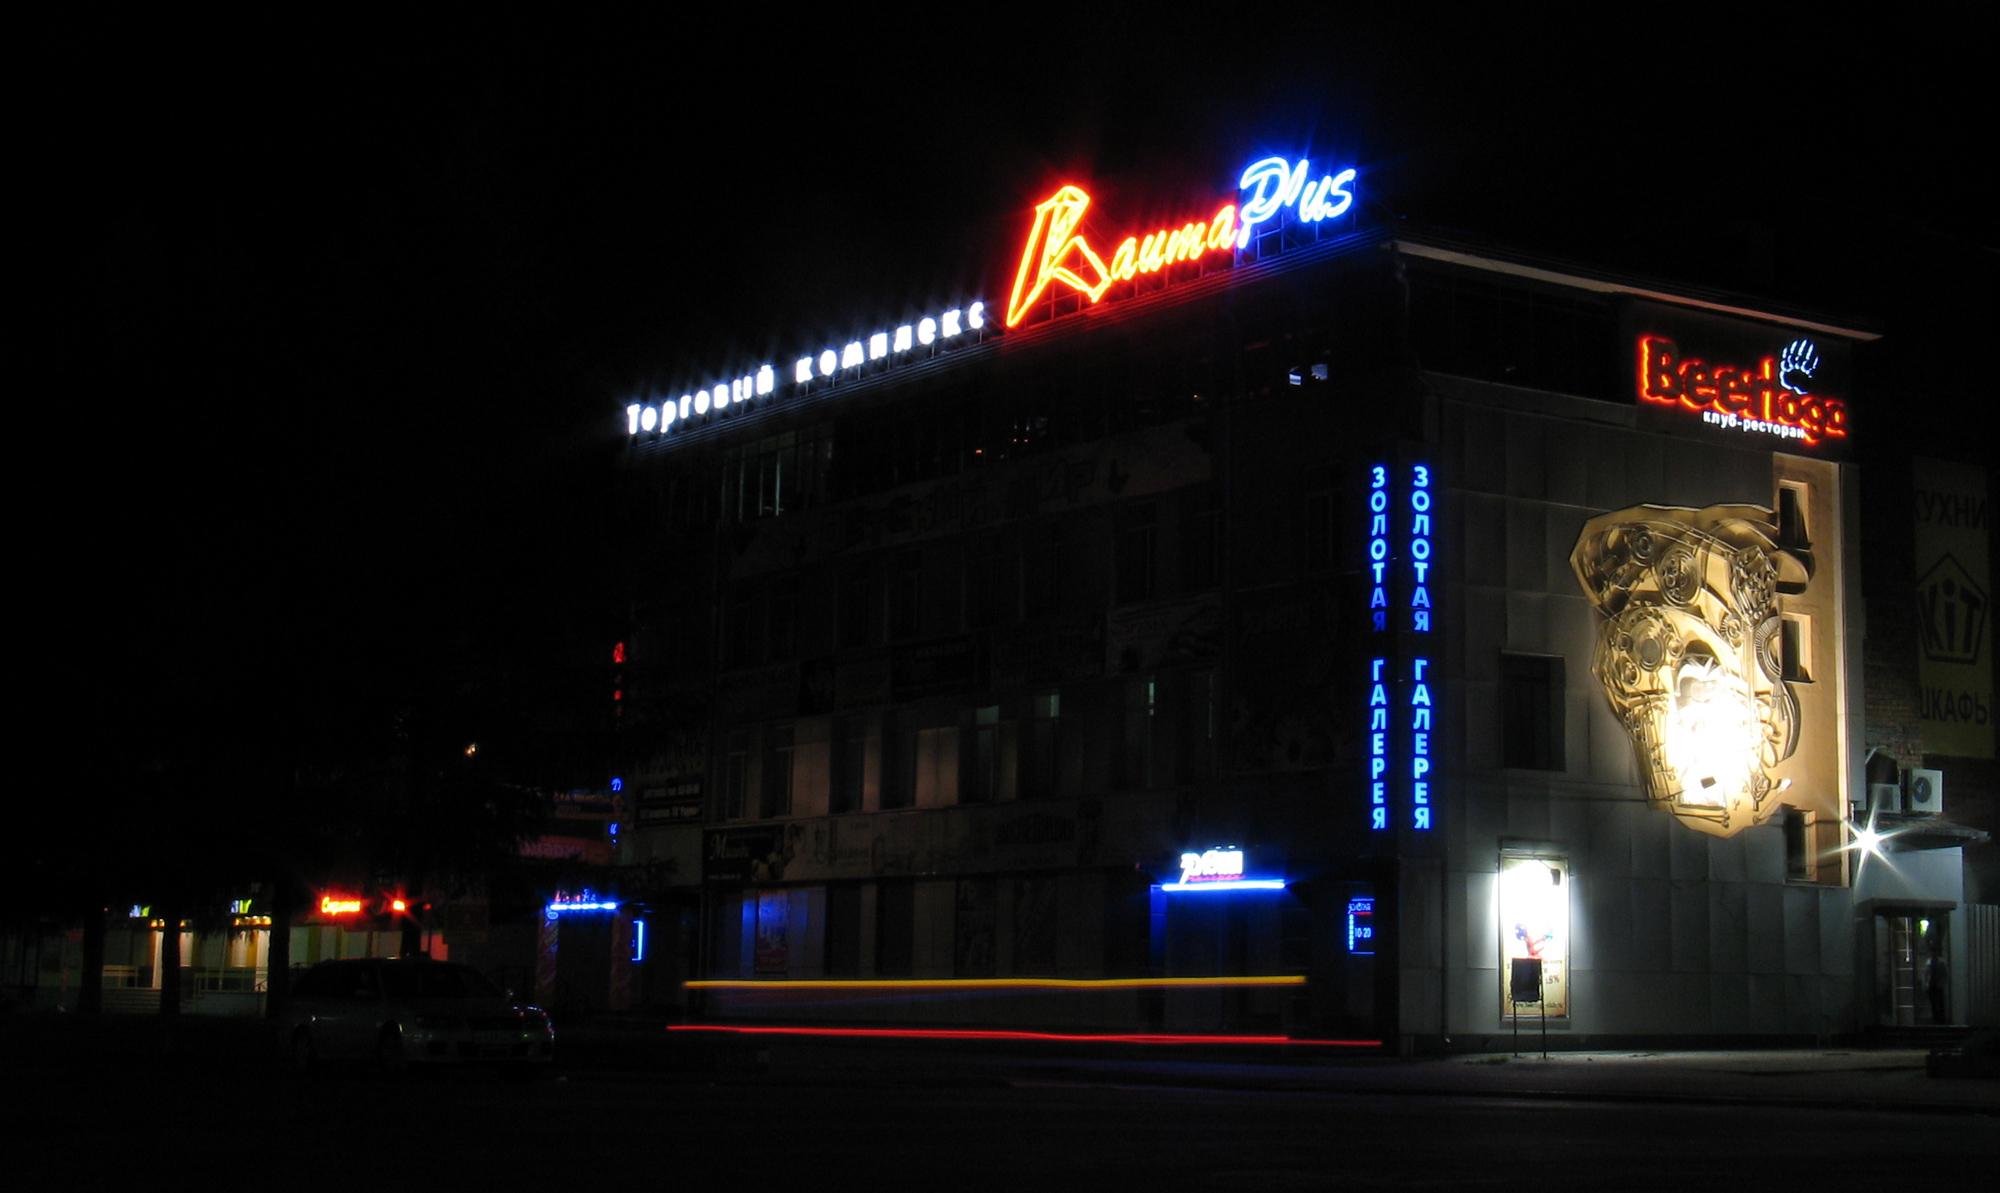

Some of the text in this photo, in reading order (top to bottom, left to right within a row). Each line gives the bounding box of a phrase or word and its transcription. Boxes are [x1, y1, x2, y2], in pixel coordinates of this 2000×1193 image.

[1238, 156, 1357, 249] Plus
[626, 301, 985, 435] Торговый комплекс
[1703, 410, 1806, 440] клуб-ресторан
[1370, 466, 1388, 830] ЗОЛОТАЯ ГАЛЕРЕЯ
[1411, 466, 1431, 830] ЗОЛОТАЯ ГАЛЕРЕЯ
